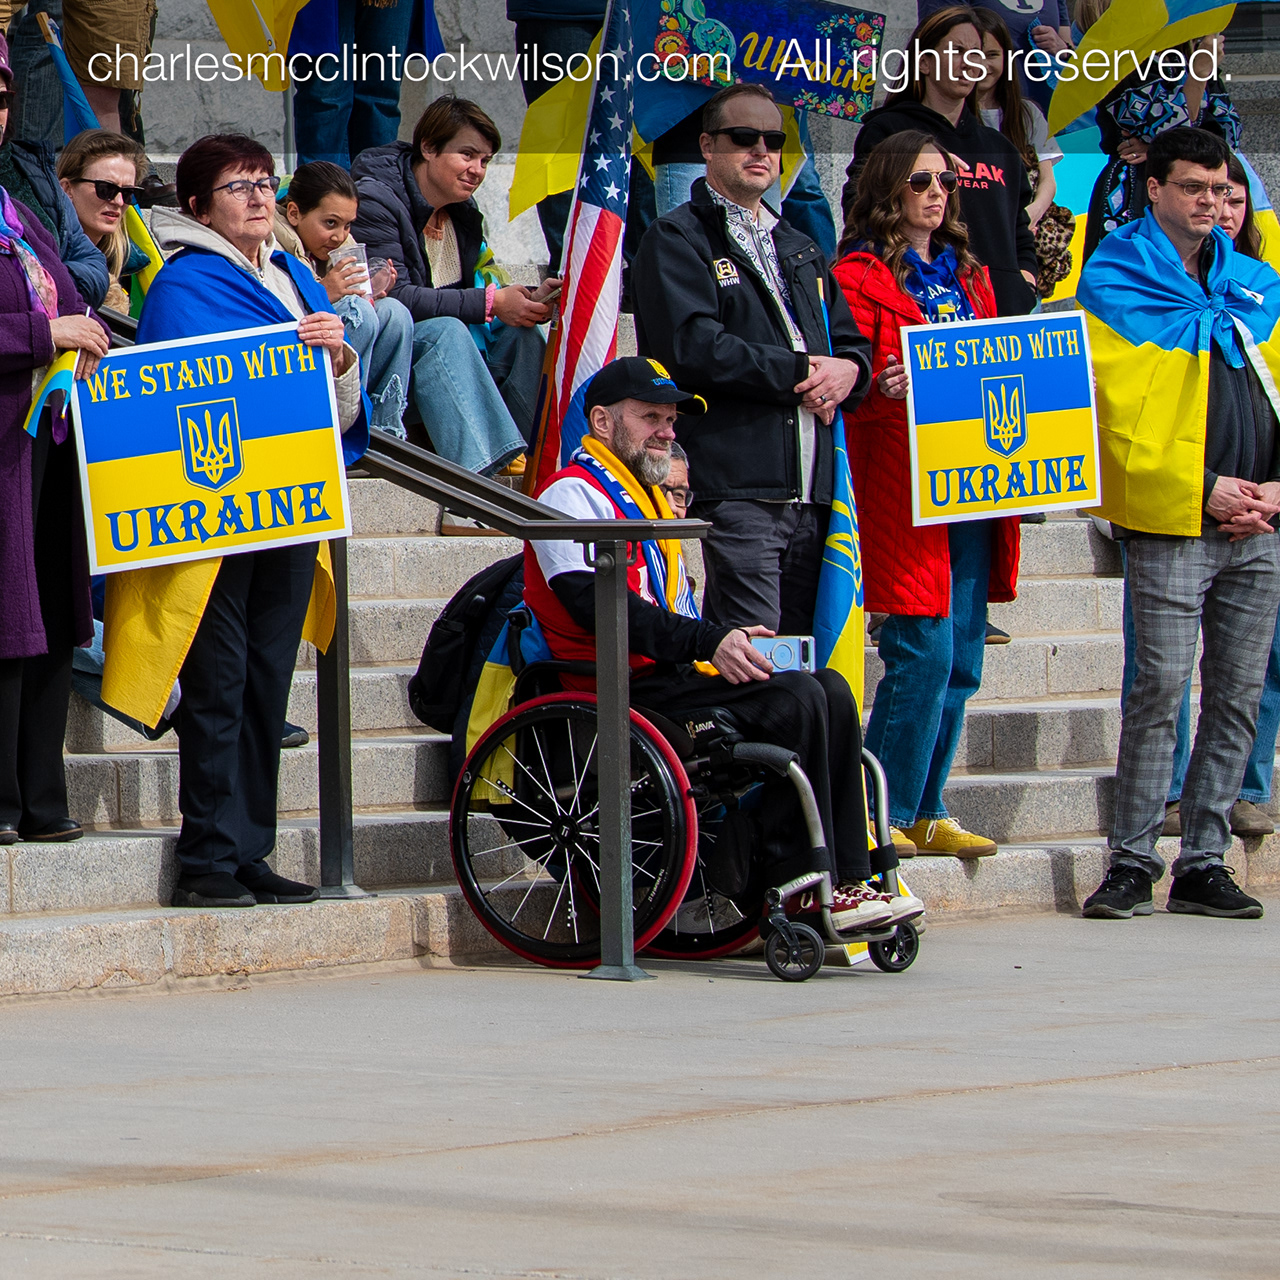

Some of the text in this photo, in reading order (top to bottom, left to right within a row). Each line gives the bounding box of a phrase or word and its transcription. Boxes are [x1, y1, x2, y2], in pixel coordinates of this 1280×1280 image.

[718, 277, 740, 288] WHW
[86, 340, 317, 403] WE STAND WITH
[915, 326, 1080, 370] WE STAND WITH
[927, 455, 1088, 507] UKRAINE
[104, 480, 333, 552] UKRAINE
